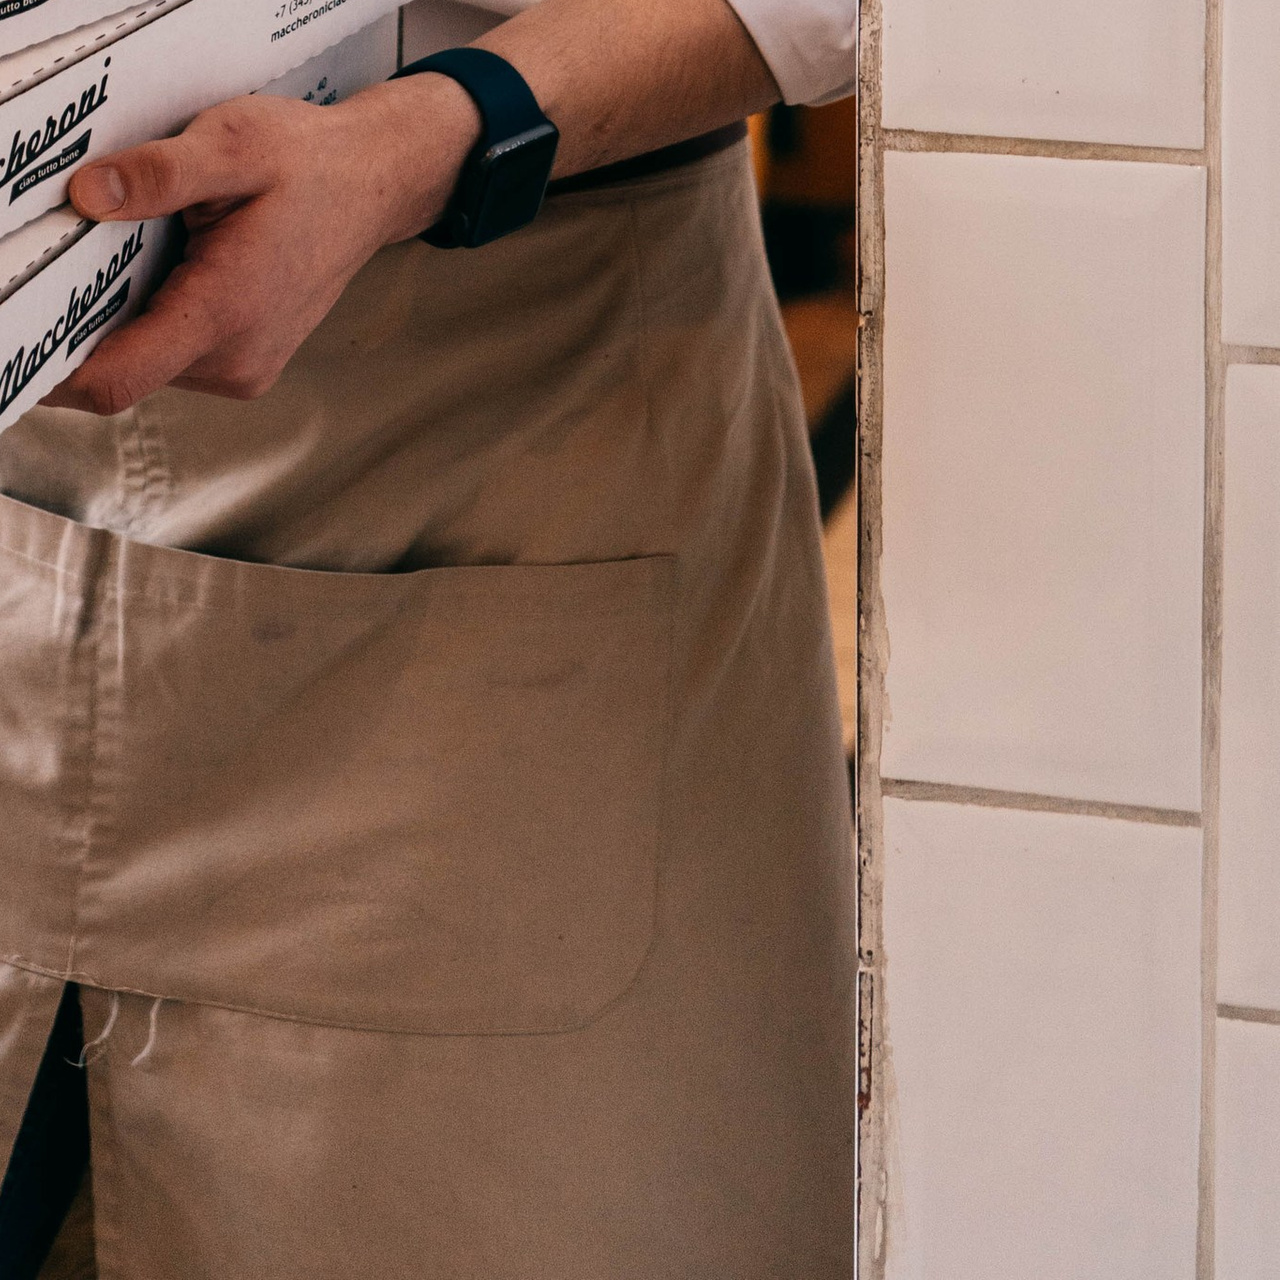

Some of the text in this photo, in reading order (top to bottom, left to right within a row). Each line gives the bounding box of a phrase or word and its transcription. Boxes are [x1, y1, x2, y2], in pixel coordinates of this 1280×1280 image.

[275, 3, 286, 18] +7
[18, 148, 80, 191] ciao tutto bene
